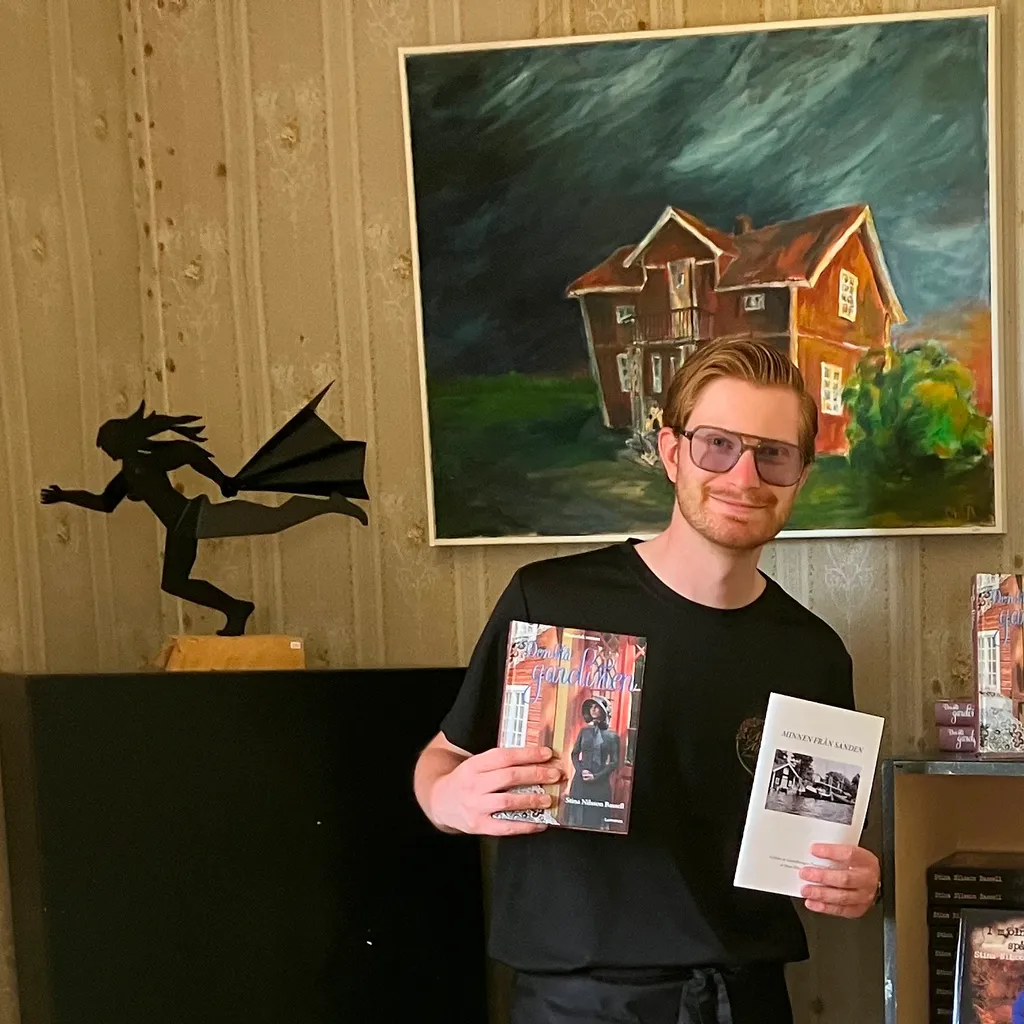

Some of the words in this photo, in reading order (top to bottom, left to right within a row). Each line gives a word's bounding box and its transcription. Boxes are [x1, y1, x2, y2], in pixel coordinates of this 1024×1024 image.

[523, 647, 638, 705] gardinen
[781, 731, 814, 743] MINNEN
[812, 736, 835, 748] FRÅN
[834, 742, 864, 753] SANDEN
[987, 926, 993, 935] I
